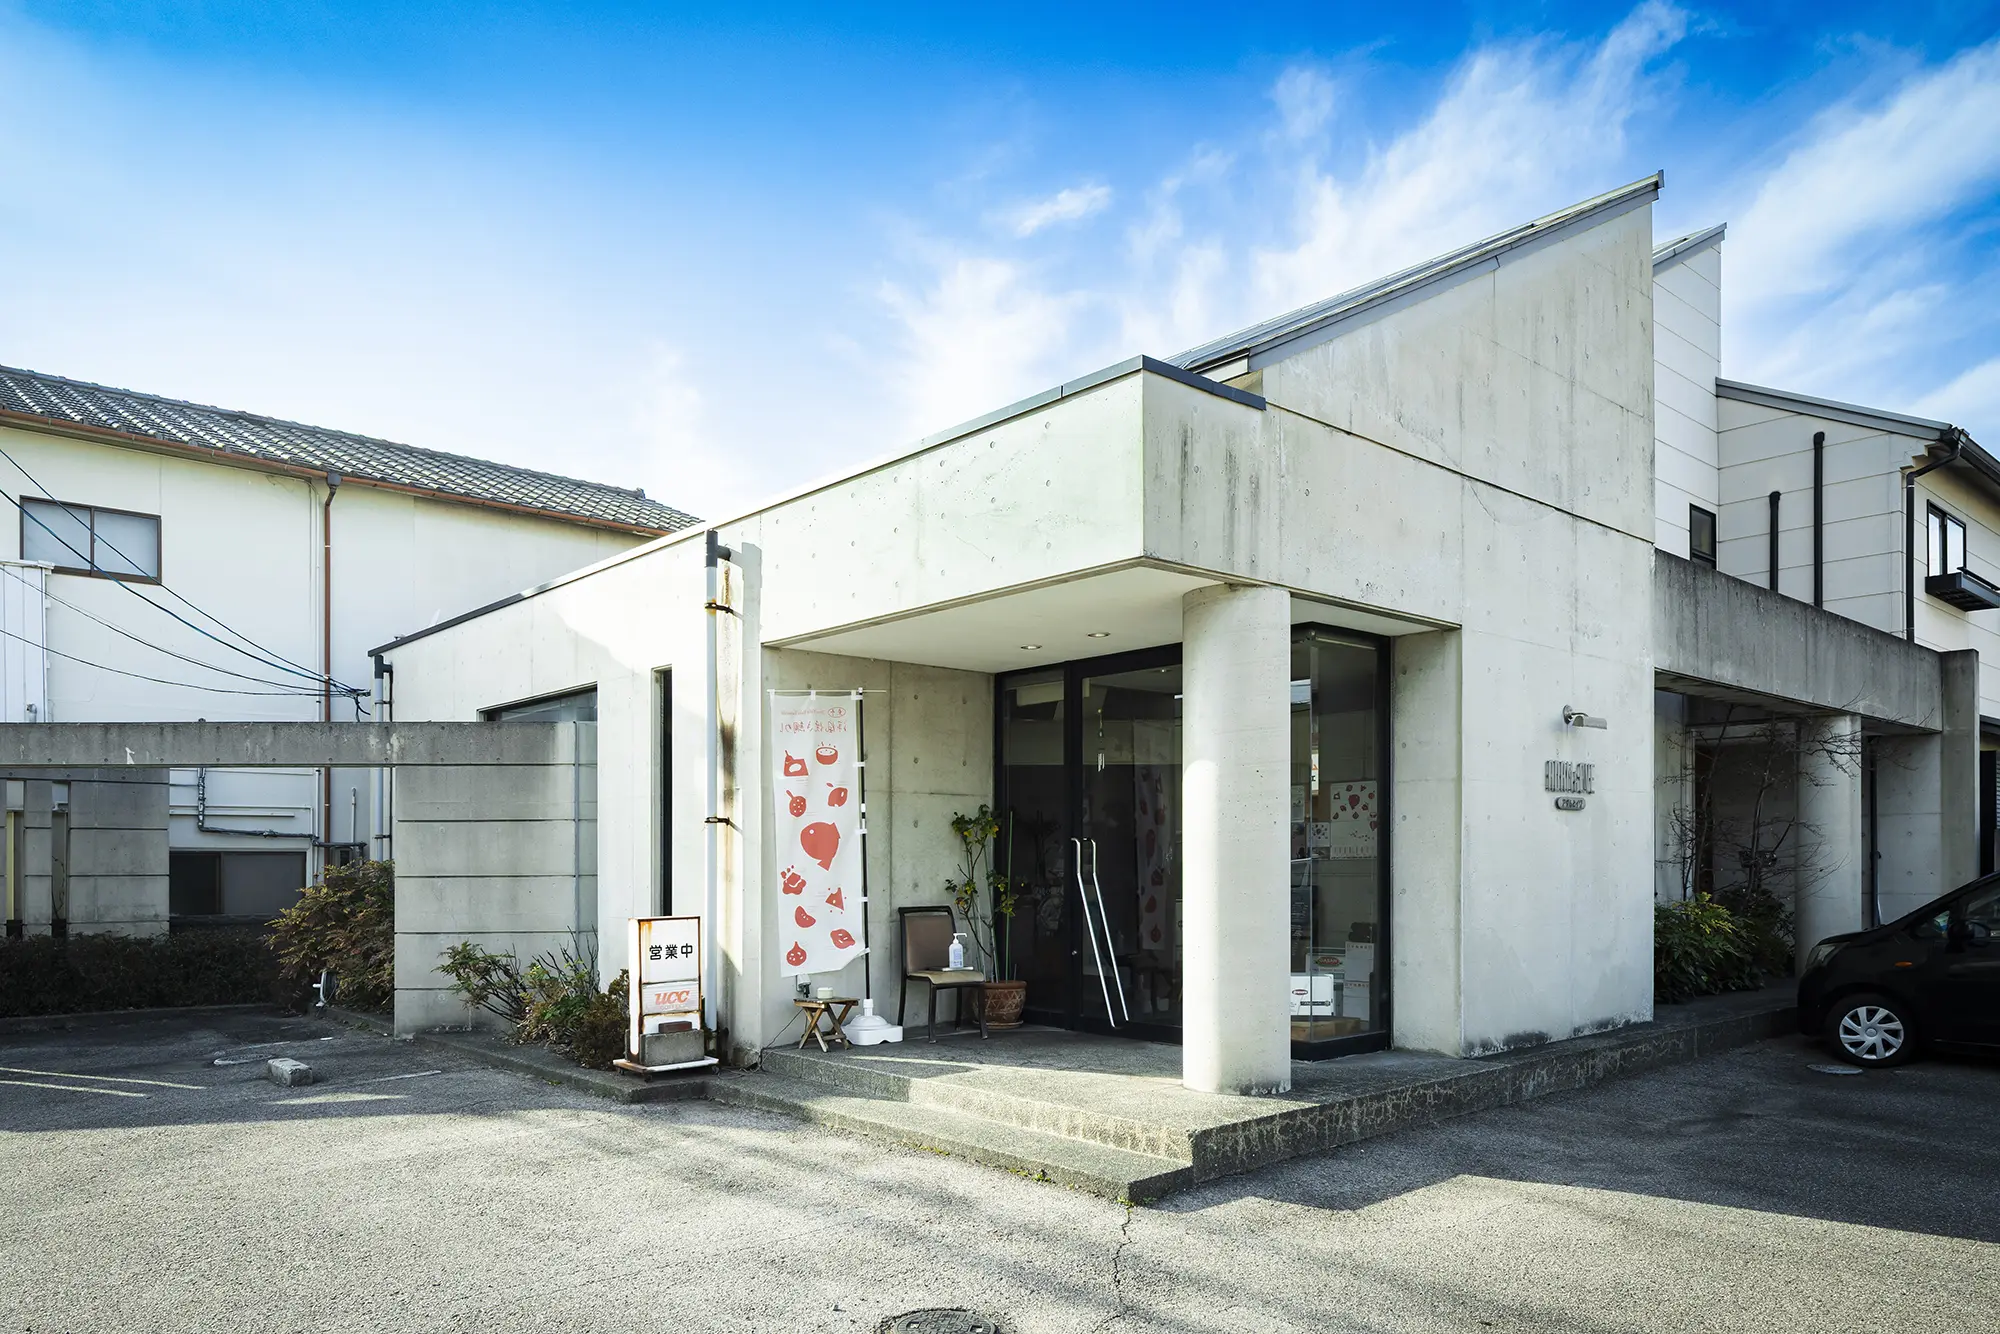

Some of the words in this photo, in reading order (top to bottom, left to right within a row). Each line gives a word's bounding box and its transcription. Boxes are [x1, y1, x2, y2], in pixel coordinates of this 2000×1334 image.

[649, 942, 693, 960] 営業中
[655, 989, 690, 1005] UCC
